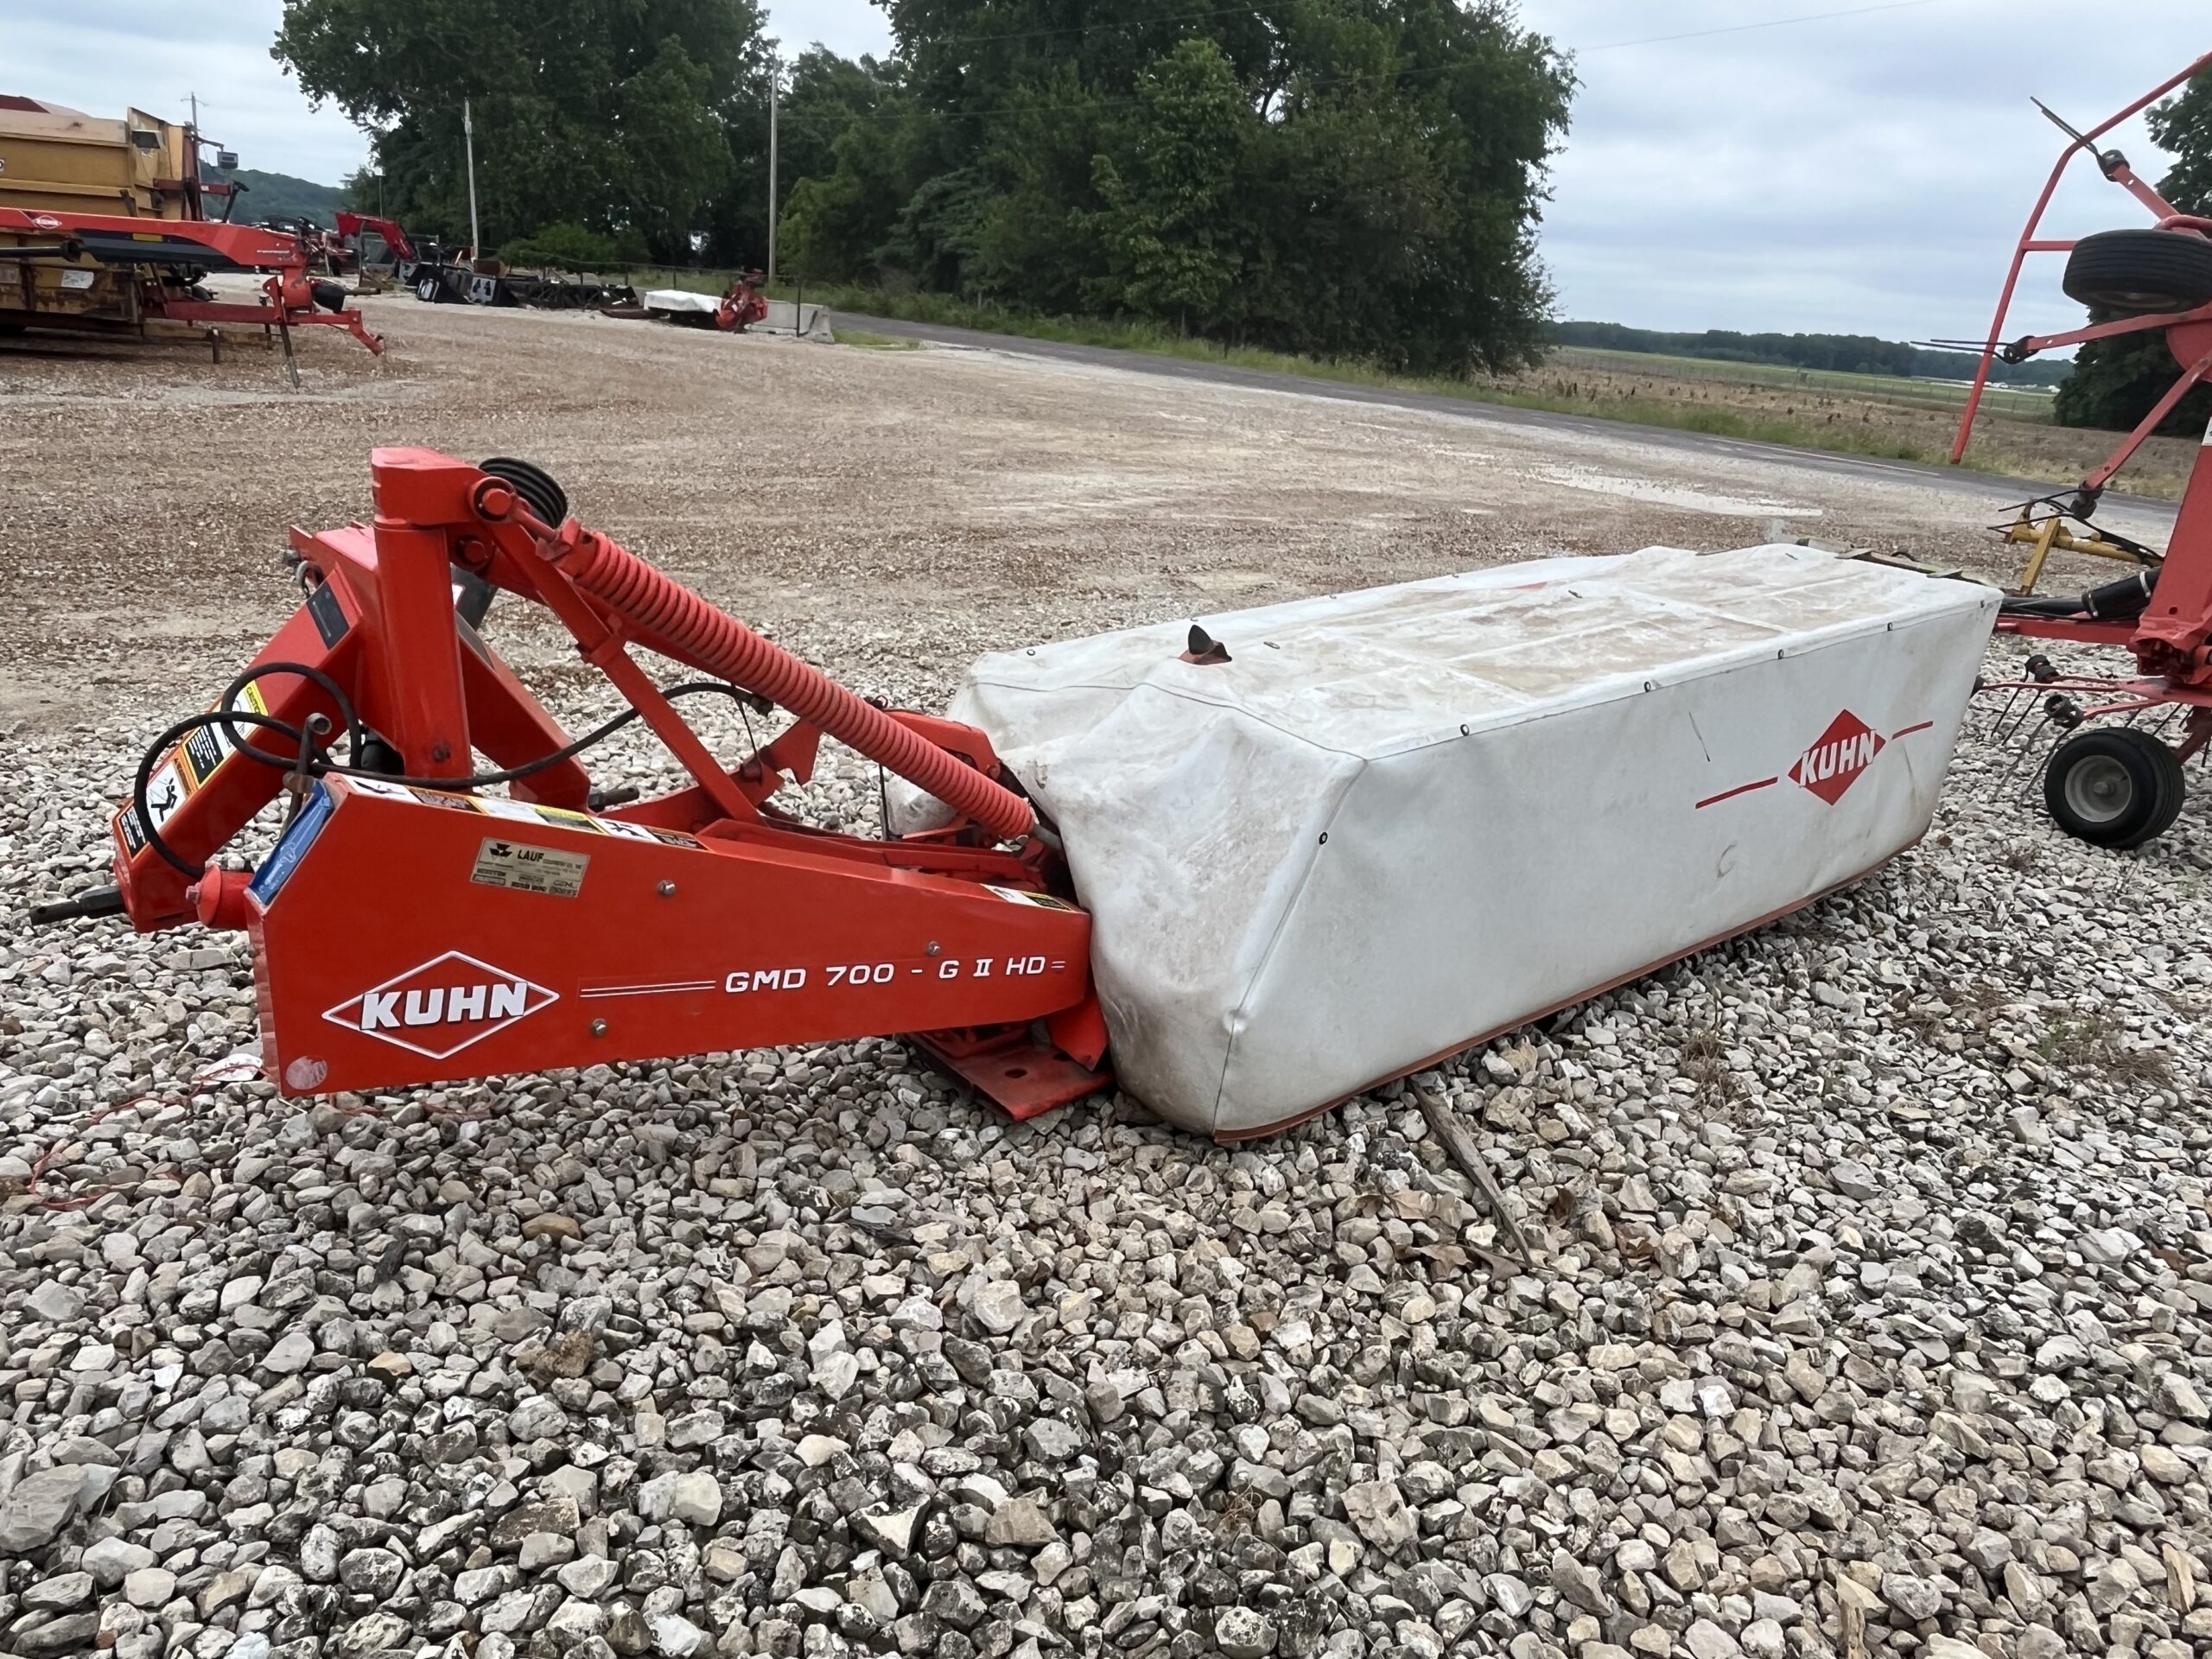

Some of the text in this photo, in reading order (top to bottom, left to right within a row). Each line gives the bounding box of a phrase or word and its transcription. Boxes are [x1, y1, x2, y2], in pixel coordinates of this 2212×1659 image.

[1799, 729, 1876, 787] KUHN
[518, 849, 544, 862] LAUF
[725, 968, 807, 993] GMD
[825, 963, 894, 987] 700
[938, 960, 960, 979] G
[1006, 956, 1046, 976] HD
[359, 982, 528, 1030] KUHN
